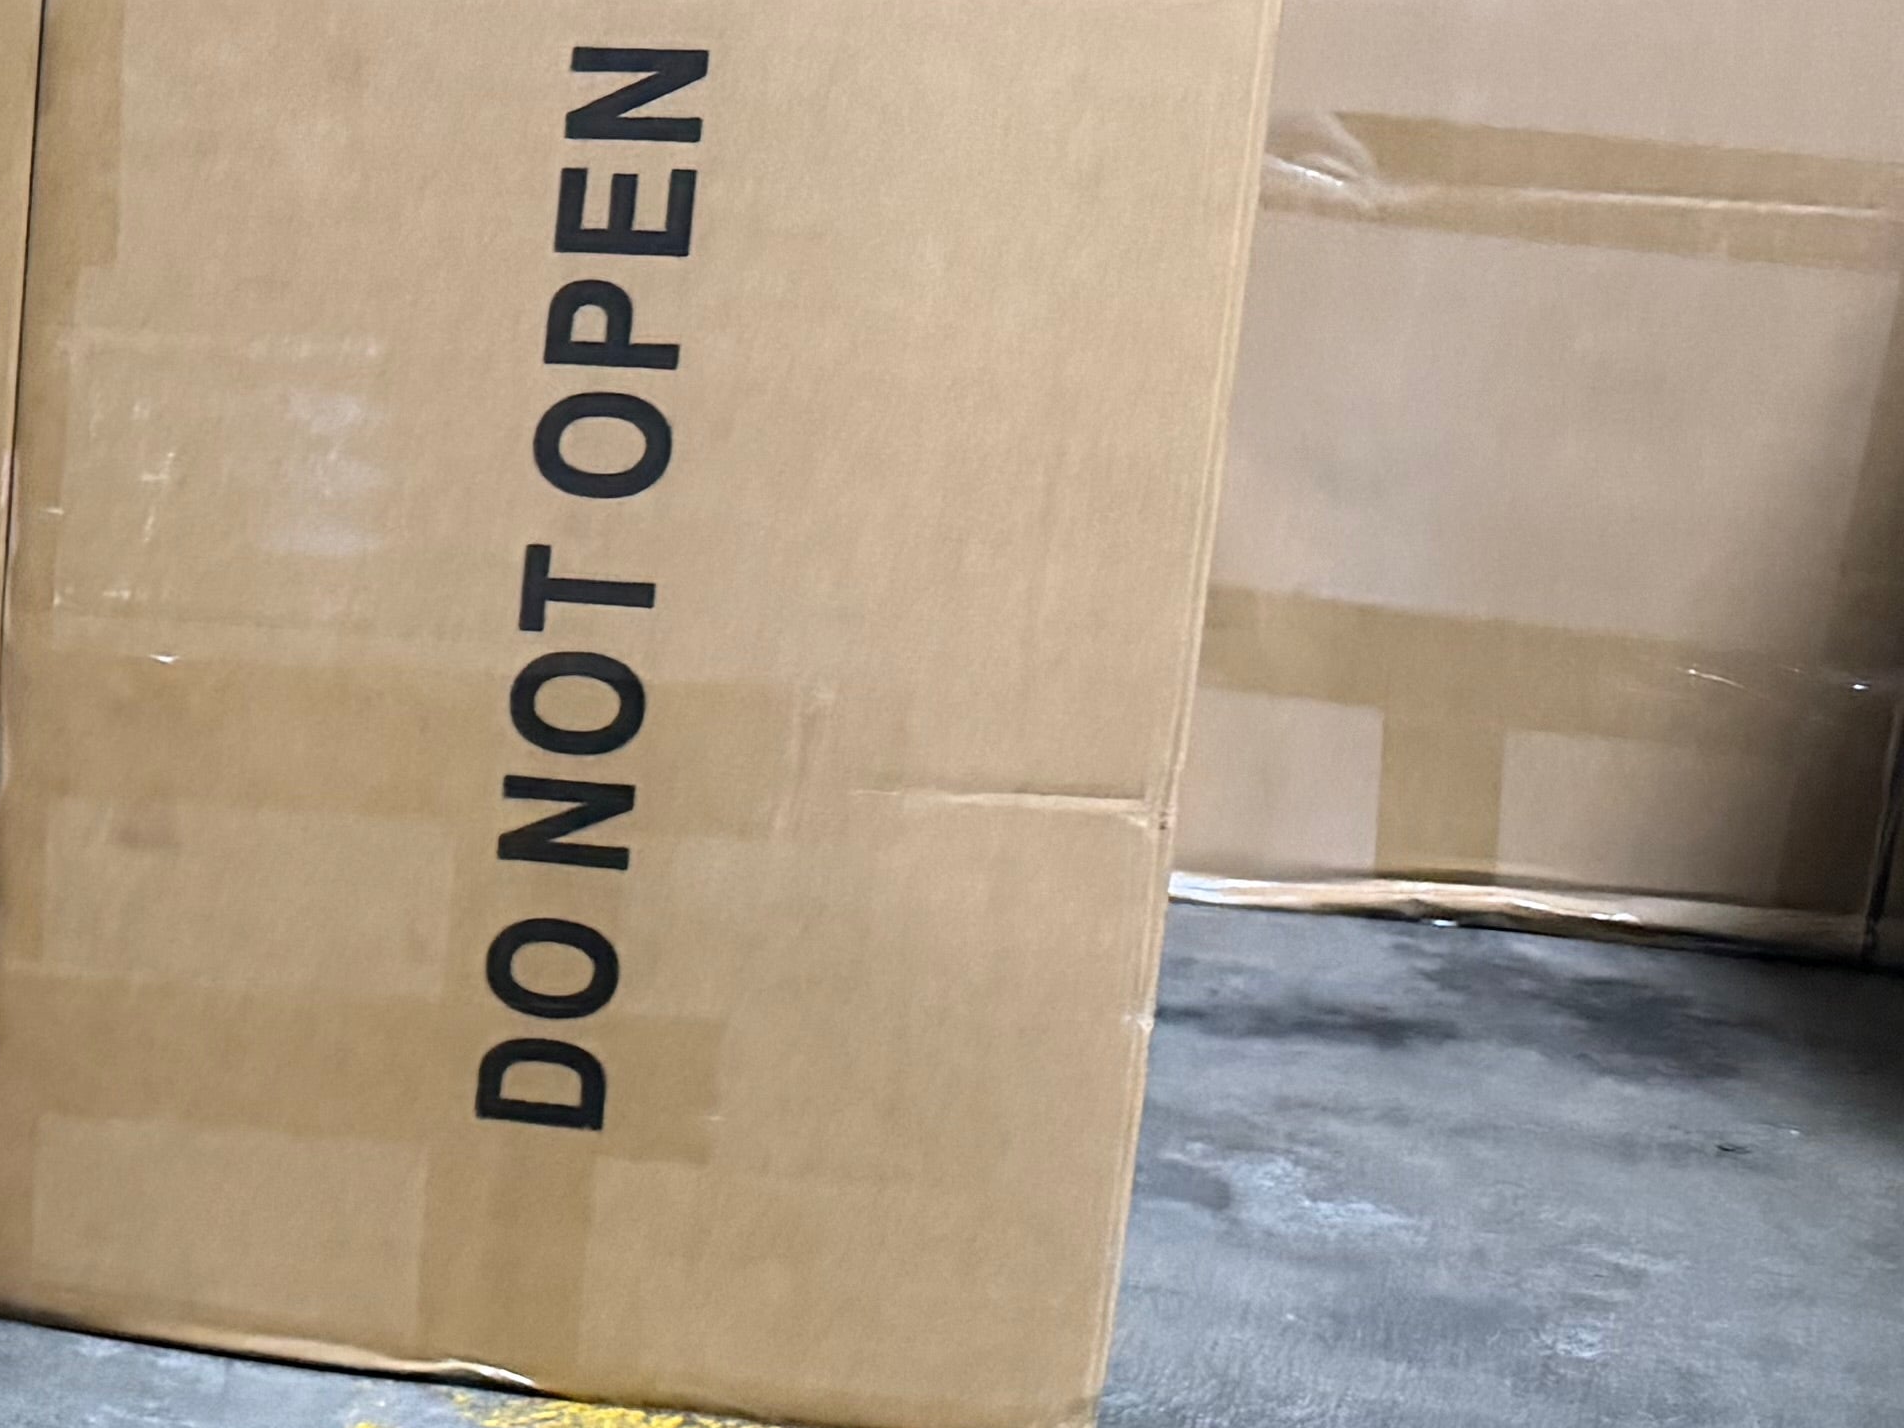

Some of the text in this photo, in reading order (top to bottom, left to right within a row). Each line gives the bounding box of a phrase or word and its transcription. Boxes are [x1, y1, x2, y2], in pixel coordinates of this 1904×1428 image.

[533, 46, 710, 500] OPEN
[496, 543, 656, 872] NOT
[474, 917, 620, 1133] DO
